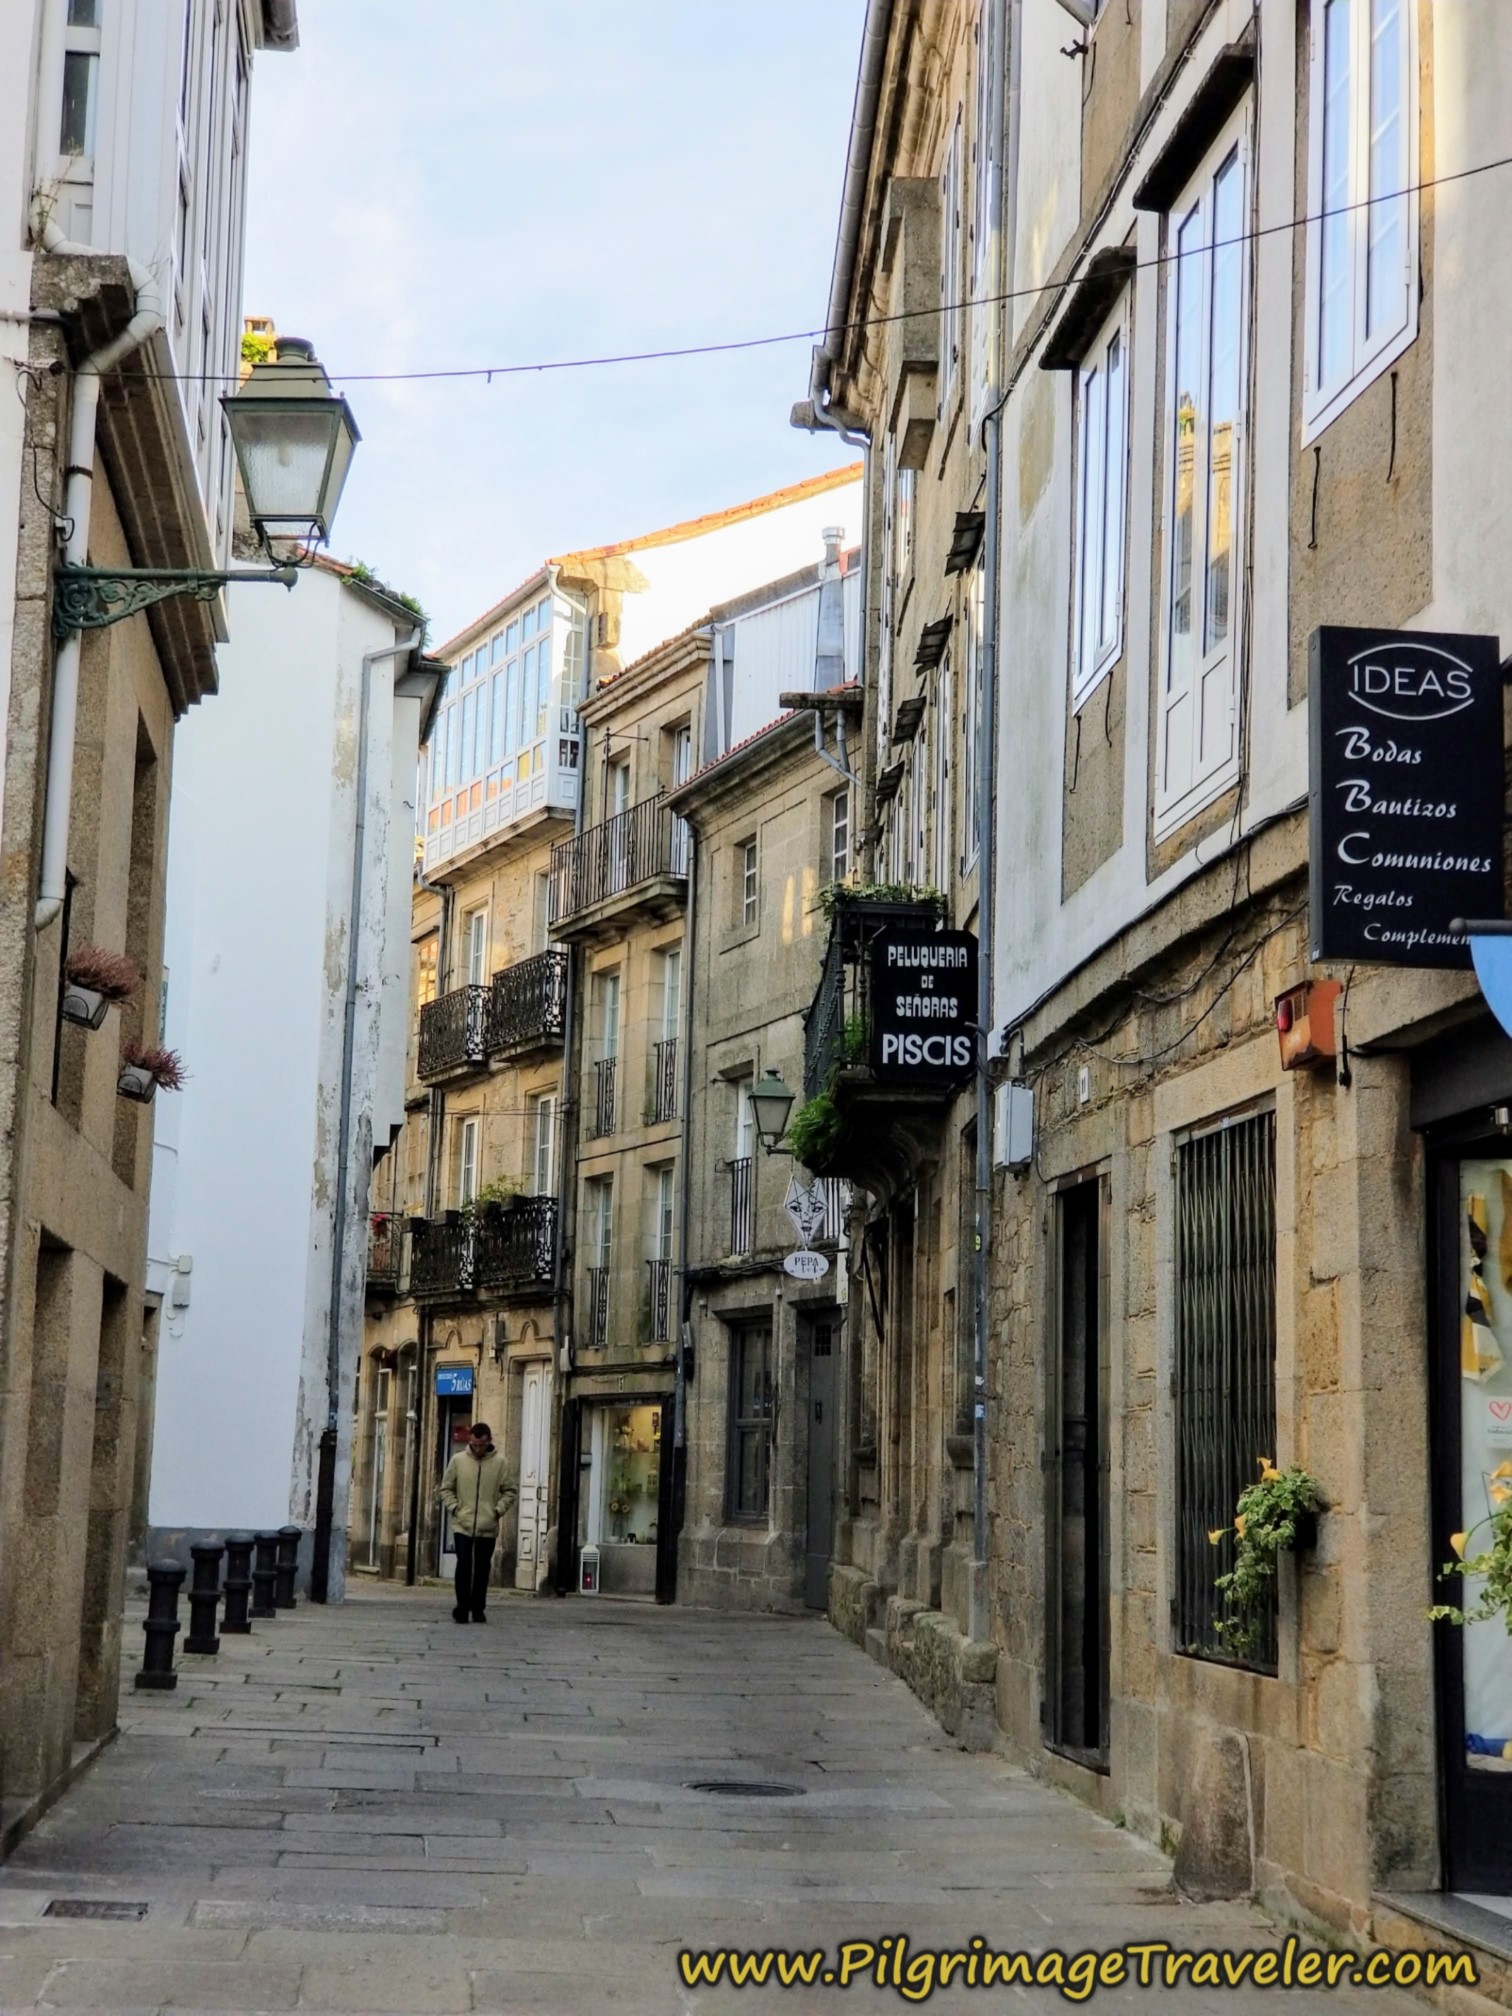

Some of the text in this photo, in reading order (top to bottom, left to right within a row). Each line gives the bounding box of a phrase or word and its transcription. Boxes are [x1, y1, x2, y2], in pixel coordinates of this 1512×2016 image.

[1353, 664, 1472, 699] IDEAS
[1335, 726, 1423, 764] Bodas
[1335, 779, 1458, 818] Bautizos
[1337, 832, 1492, 873] Comuniones
[1333, 885, 1414, 911] Regalos
[887, 945, 967, 968] PELUQUERIA
[921, 975, 935, 989] DE
[896, 993, 958, 1018] SEÑORAS
[882, 1033, 972, 1066] PISCIS
[794, 1256, 819, 1266] PEPA
